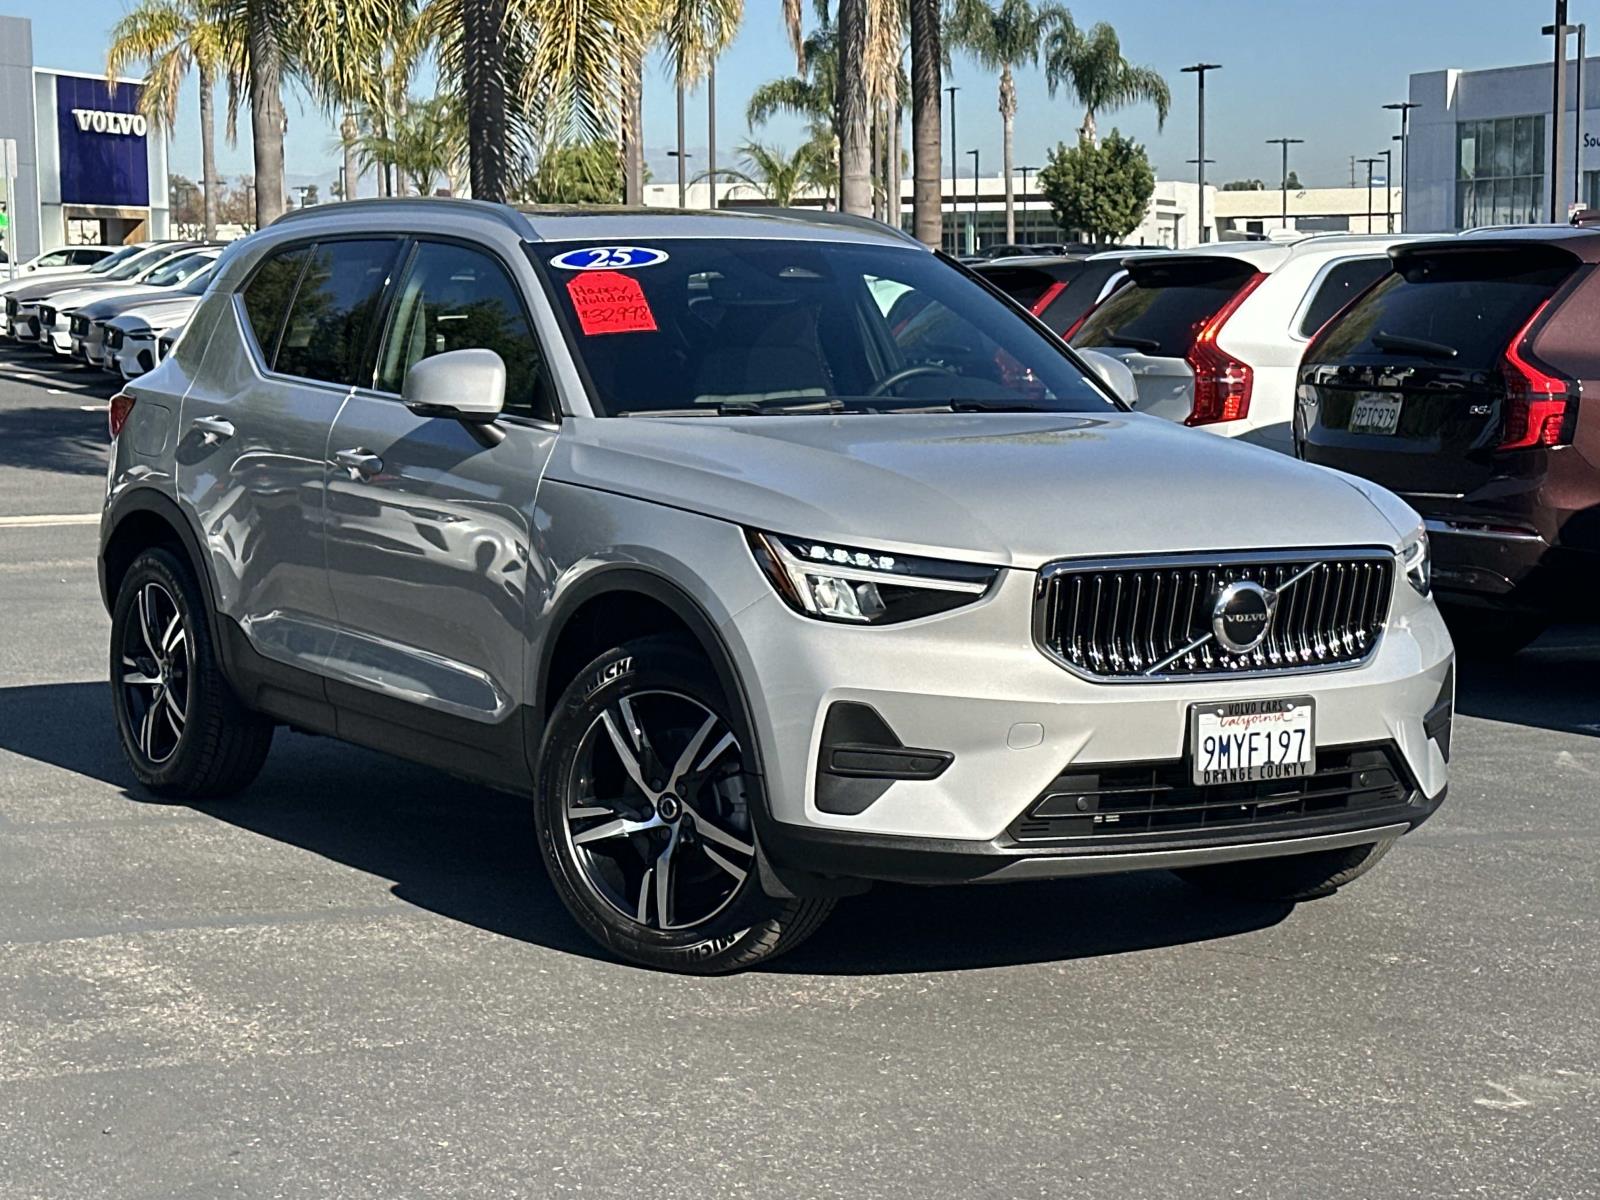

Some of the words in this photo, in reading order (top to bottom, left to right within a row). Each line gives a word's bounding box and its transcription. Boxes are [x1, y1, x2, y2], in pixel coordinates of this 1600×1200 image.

[72, 109, 147, 136] VOLVO
[585, 247, 634, 268] 25
[1354, 406, 1396, 426] 9PTC979
[1225, 613, 1266, 622] VOLVO
[1228, 702, 1257, 716] VOLVO
[1260, 700, 1283, 714] CARS
[1220, 711, 1286, 731] California
[1203, 728, 1306, 771] 9MYF197
[1203, 766, 1253, 785] ORANGE
[1260, 762, 1307, 779] COUNTY
